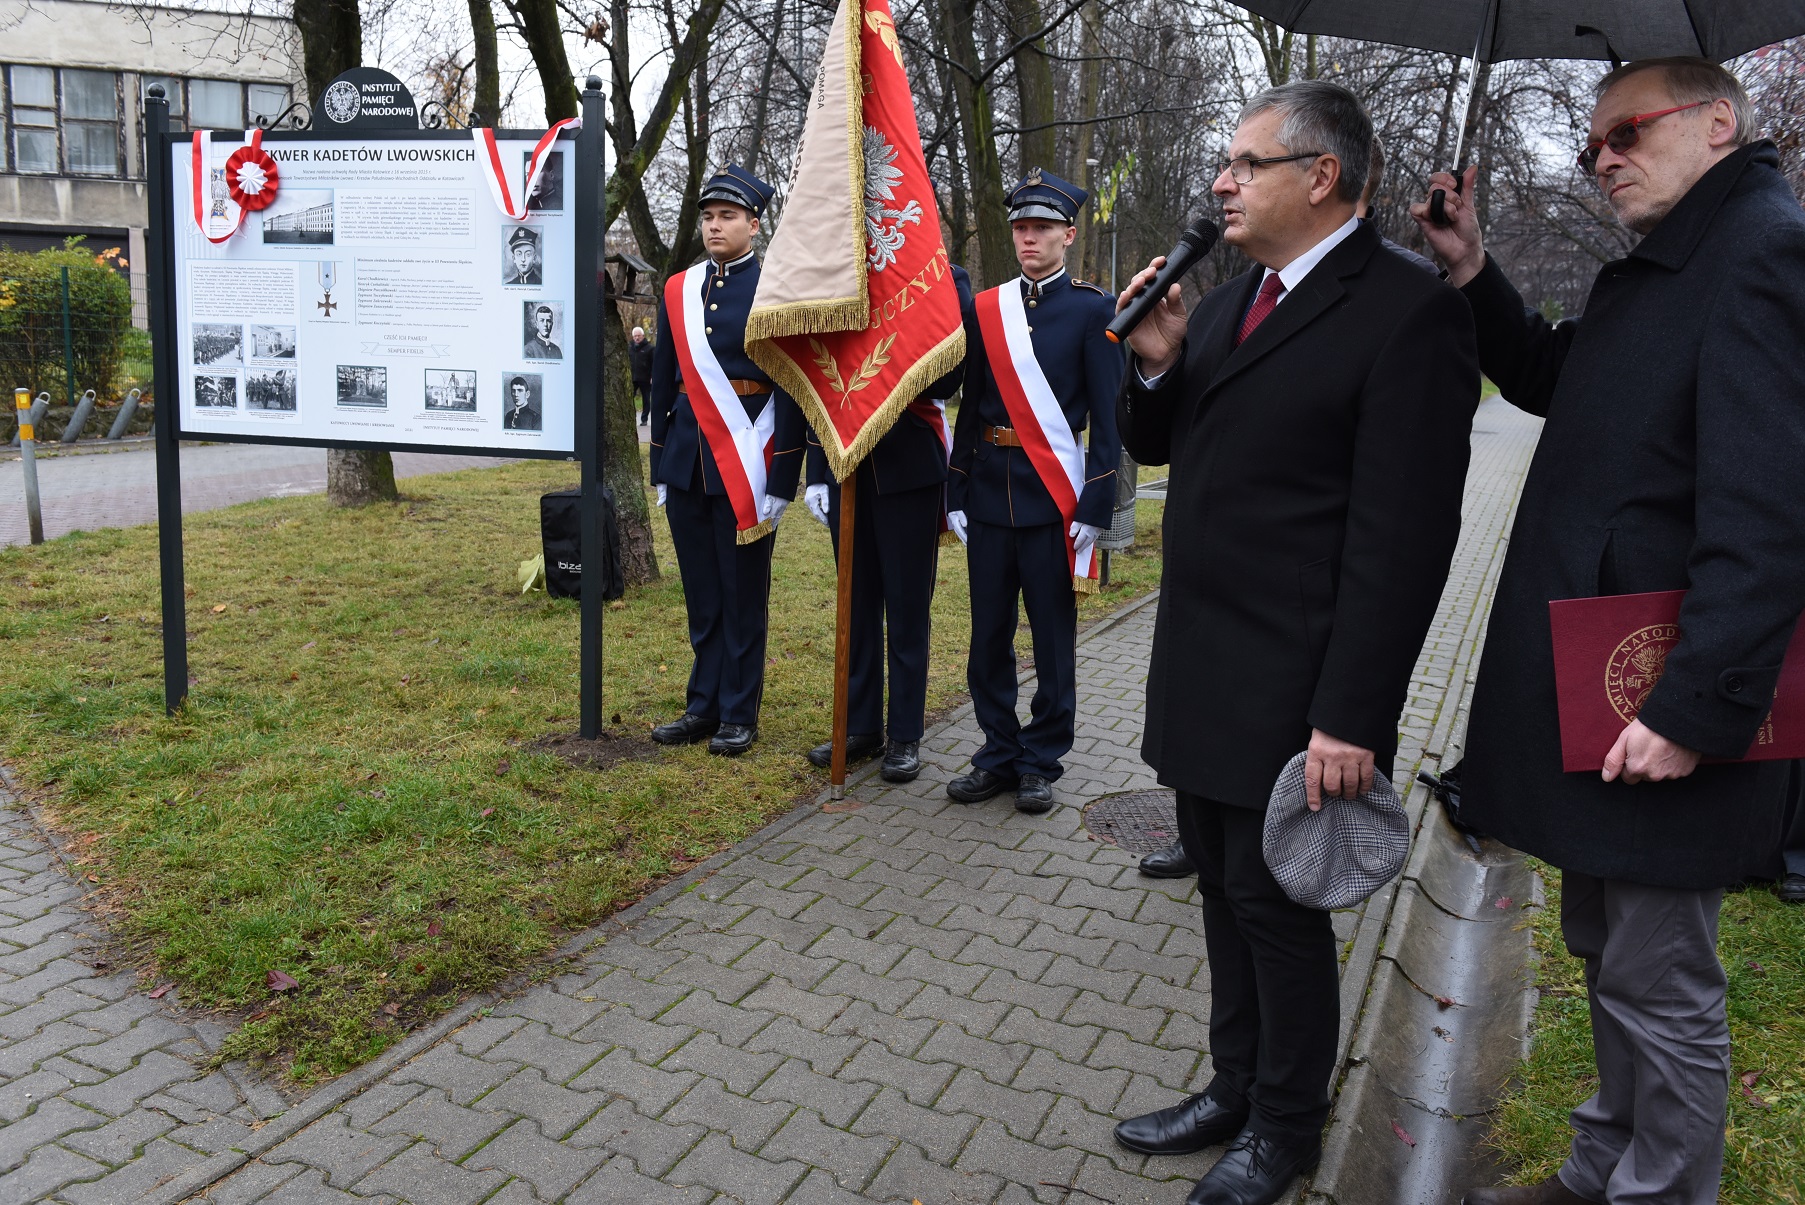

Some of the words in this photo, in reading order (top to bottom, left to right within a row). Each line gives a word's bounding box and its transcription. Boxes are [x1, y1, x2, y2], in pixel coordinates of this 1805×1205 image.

[362, 83, 401, 92] INSTYTUT
[817, 66, 826, 110] POMAGA
[362, 95, 394, 106] PAMIĘCI
[361, 107, 414, 117] NARODOWEJ
[313, 146, 383, 162] KADETÓW
[387, 149, 475, 162] LWOWSKICH
[1620, 627, 1683, 655] NAROD
